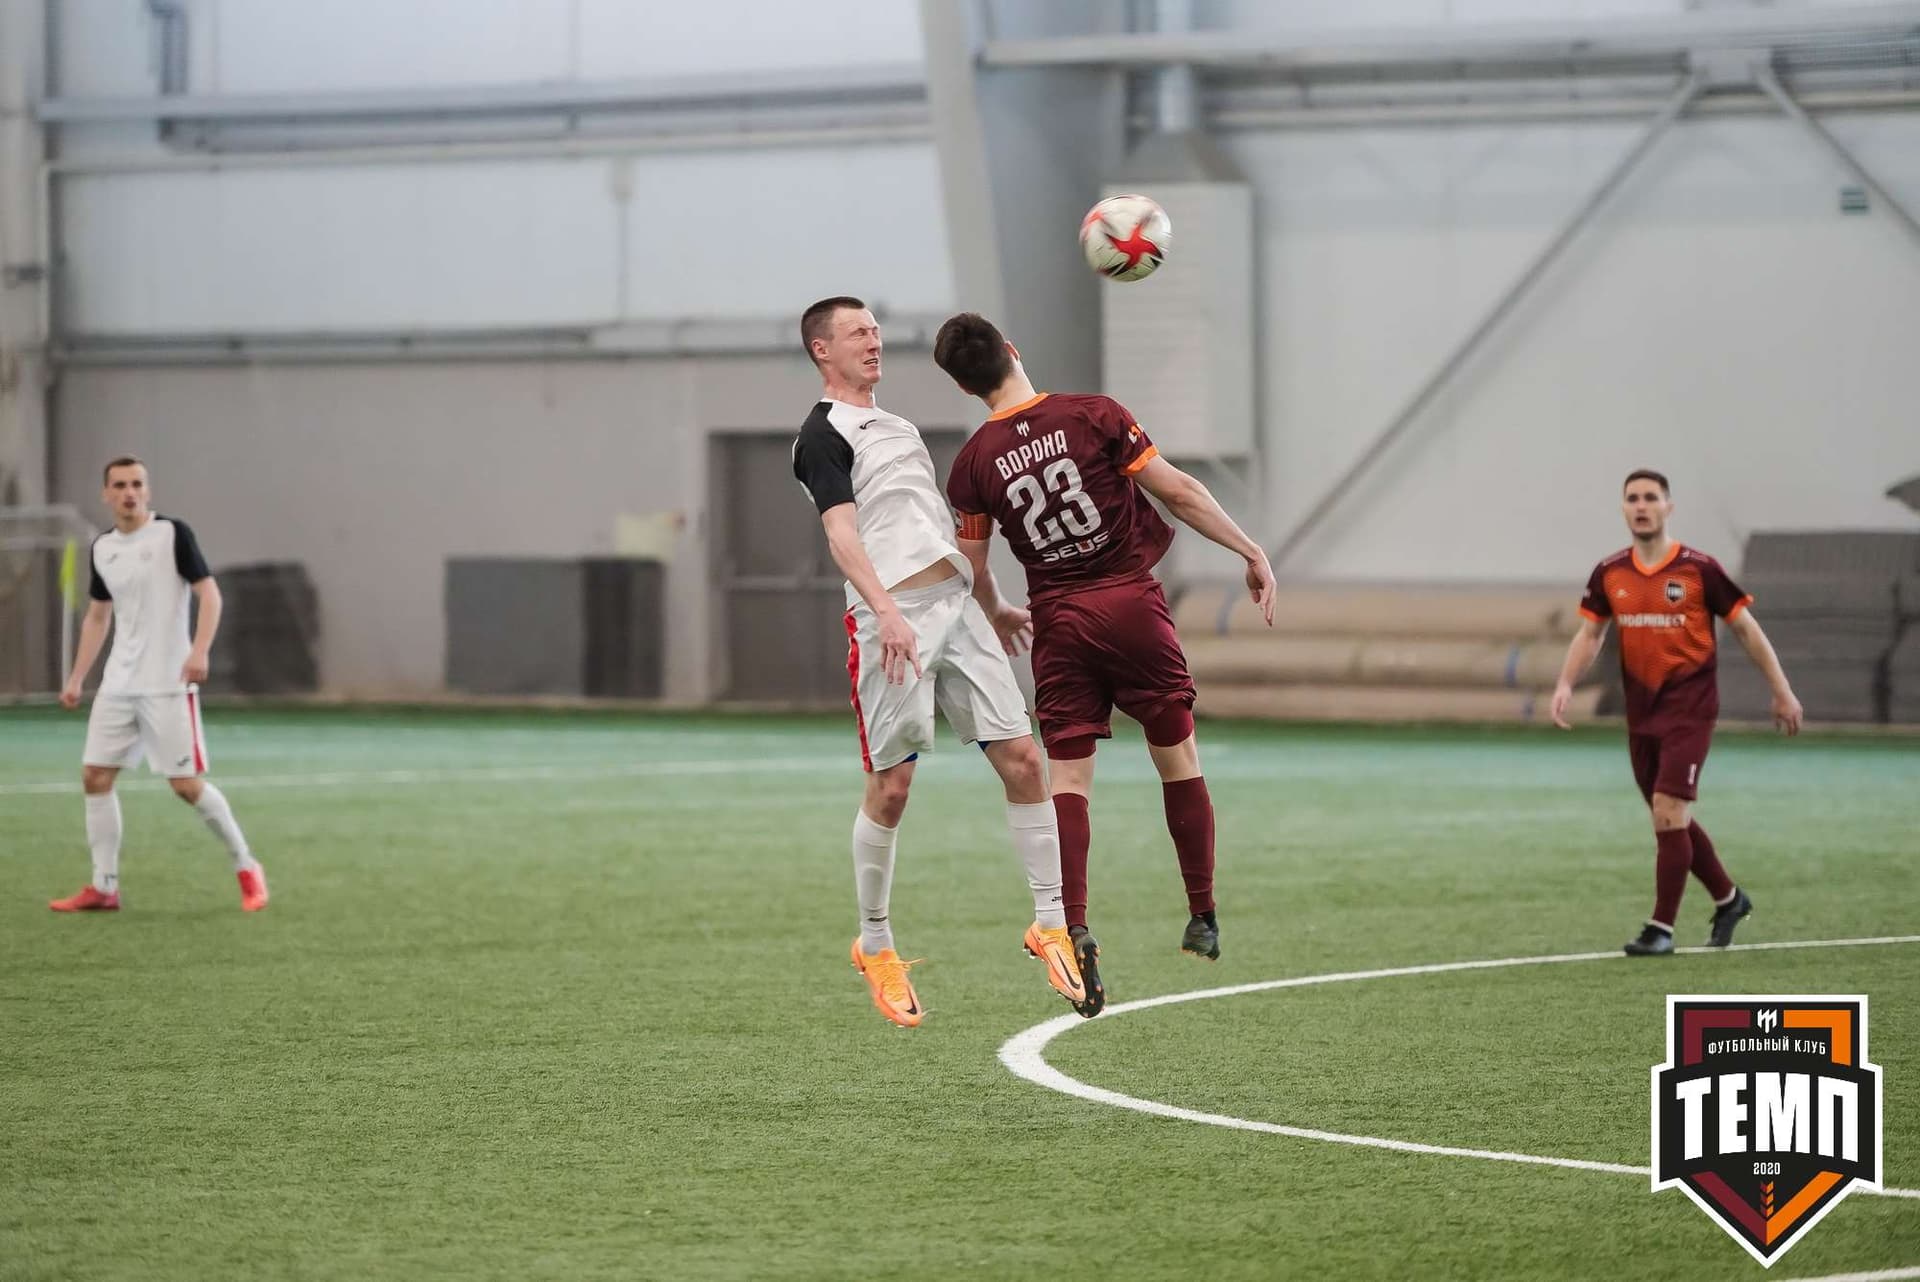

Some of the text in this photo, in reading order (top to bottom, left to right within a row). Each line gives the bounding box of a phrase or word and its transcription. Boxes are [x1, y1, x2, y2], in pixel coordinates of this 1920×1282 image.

[995, 429, 1069, 481] ВОРОНА
[1006, 458, 1102, 550] 23
[1042, 530, 1111, 562] SEUS
